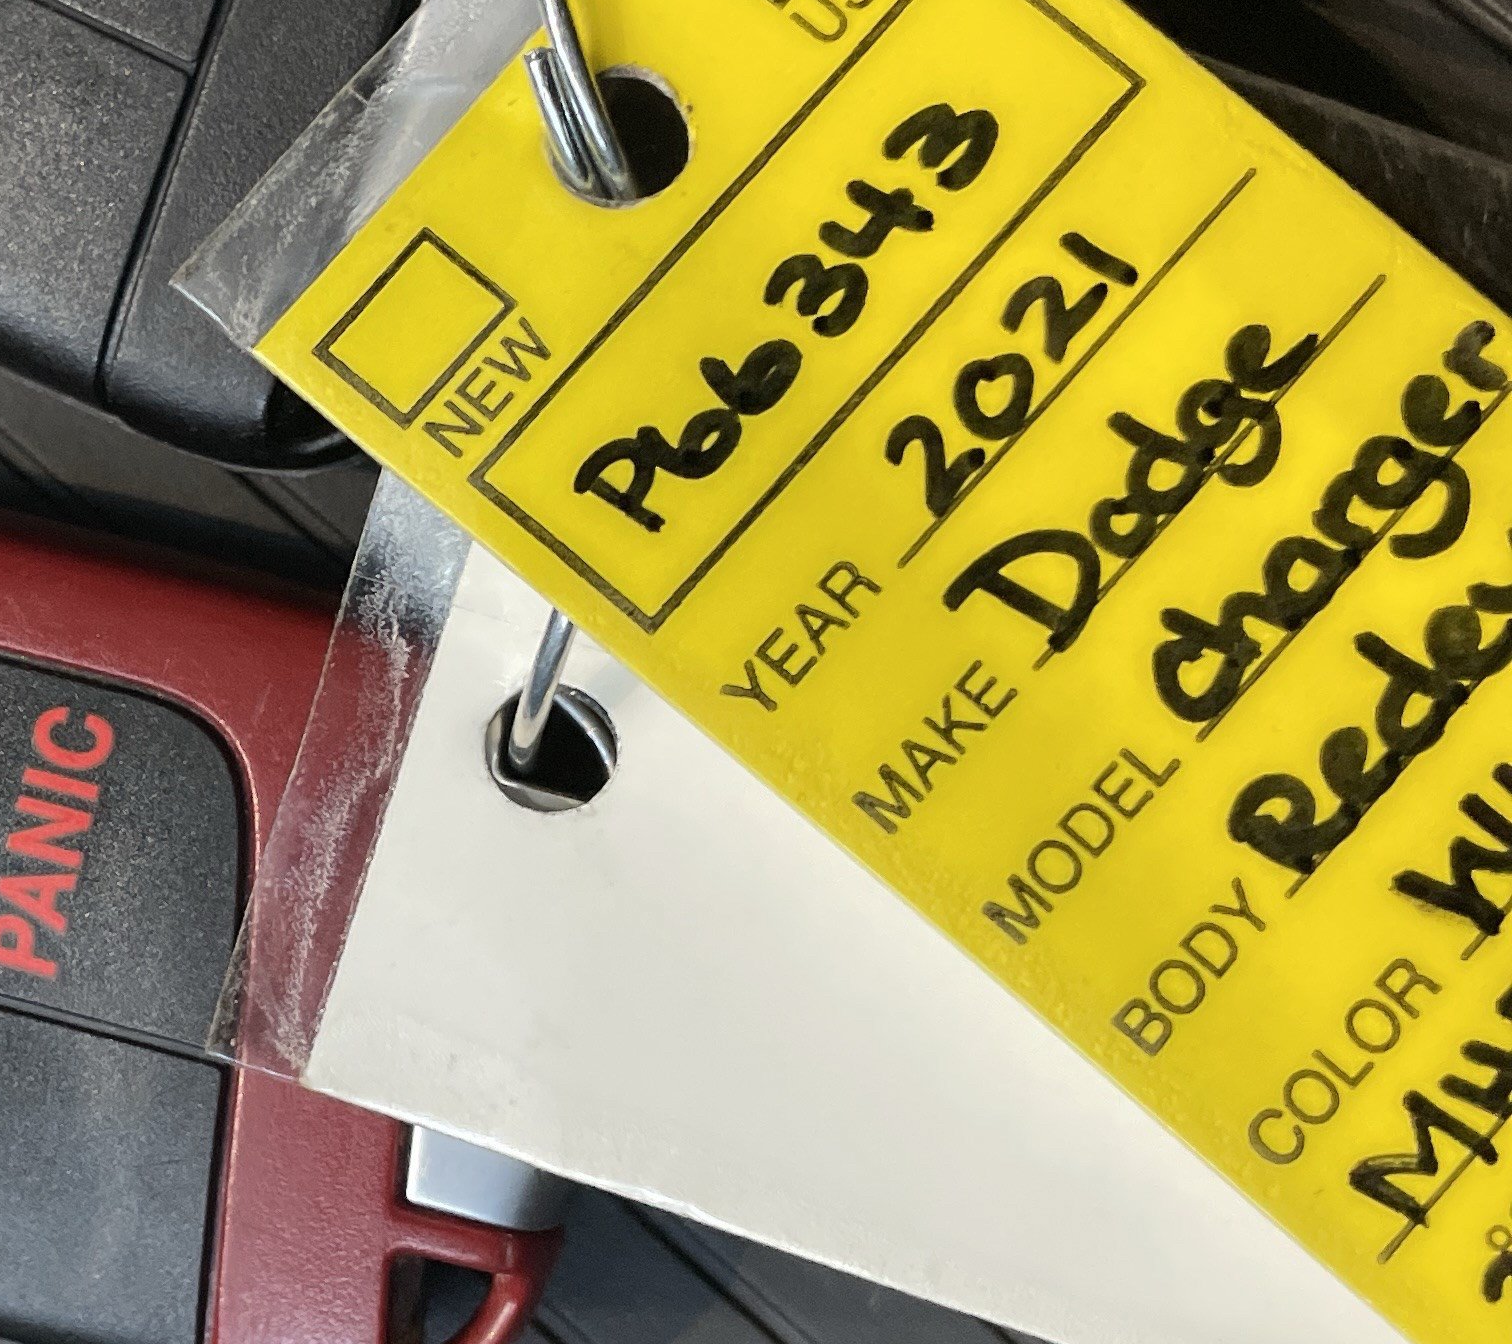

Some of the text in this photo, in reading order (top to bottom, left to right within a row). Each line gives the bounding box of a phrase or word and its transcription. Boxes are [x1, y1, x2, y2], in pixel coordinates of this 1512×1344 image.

[422, 316, 552, 457] NEW
[719, 231, 1139, 712] YEAR 2021
[851, 324, 1320, 834] MAKE Dodge
[981, 748, 1181, 945] MODEL
[1111, 876, 1267, 1056] BODY
[1247, 958, 1443, 1165] COLOR
